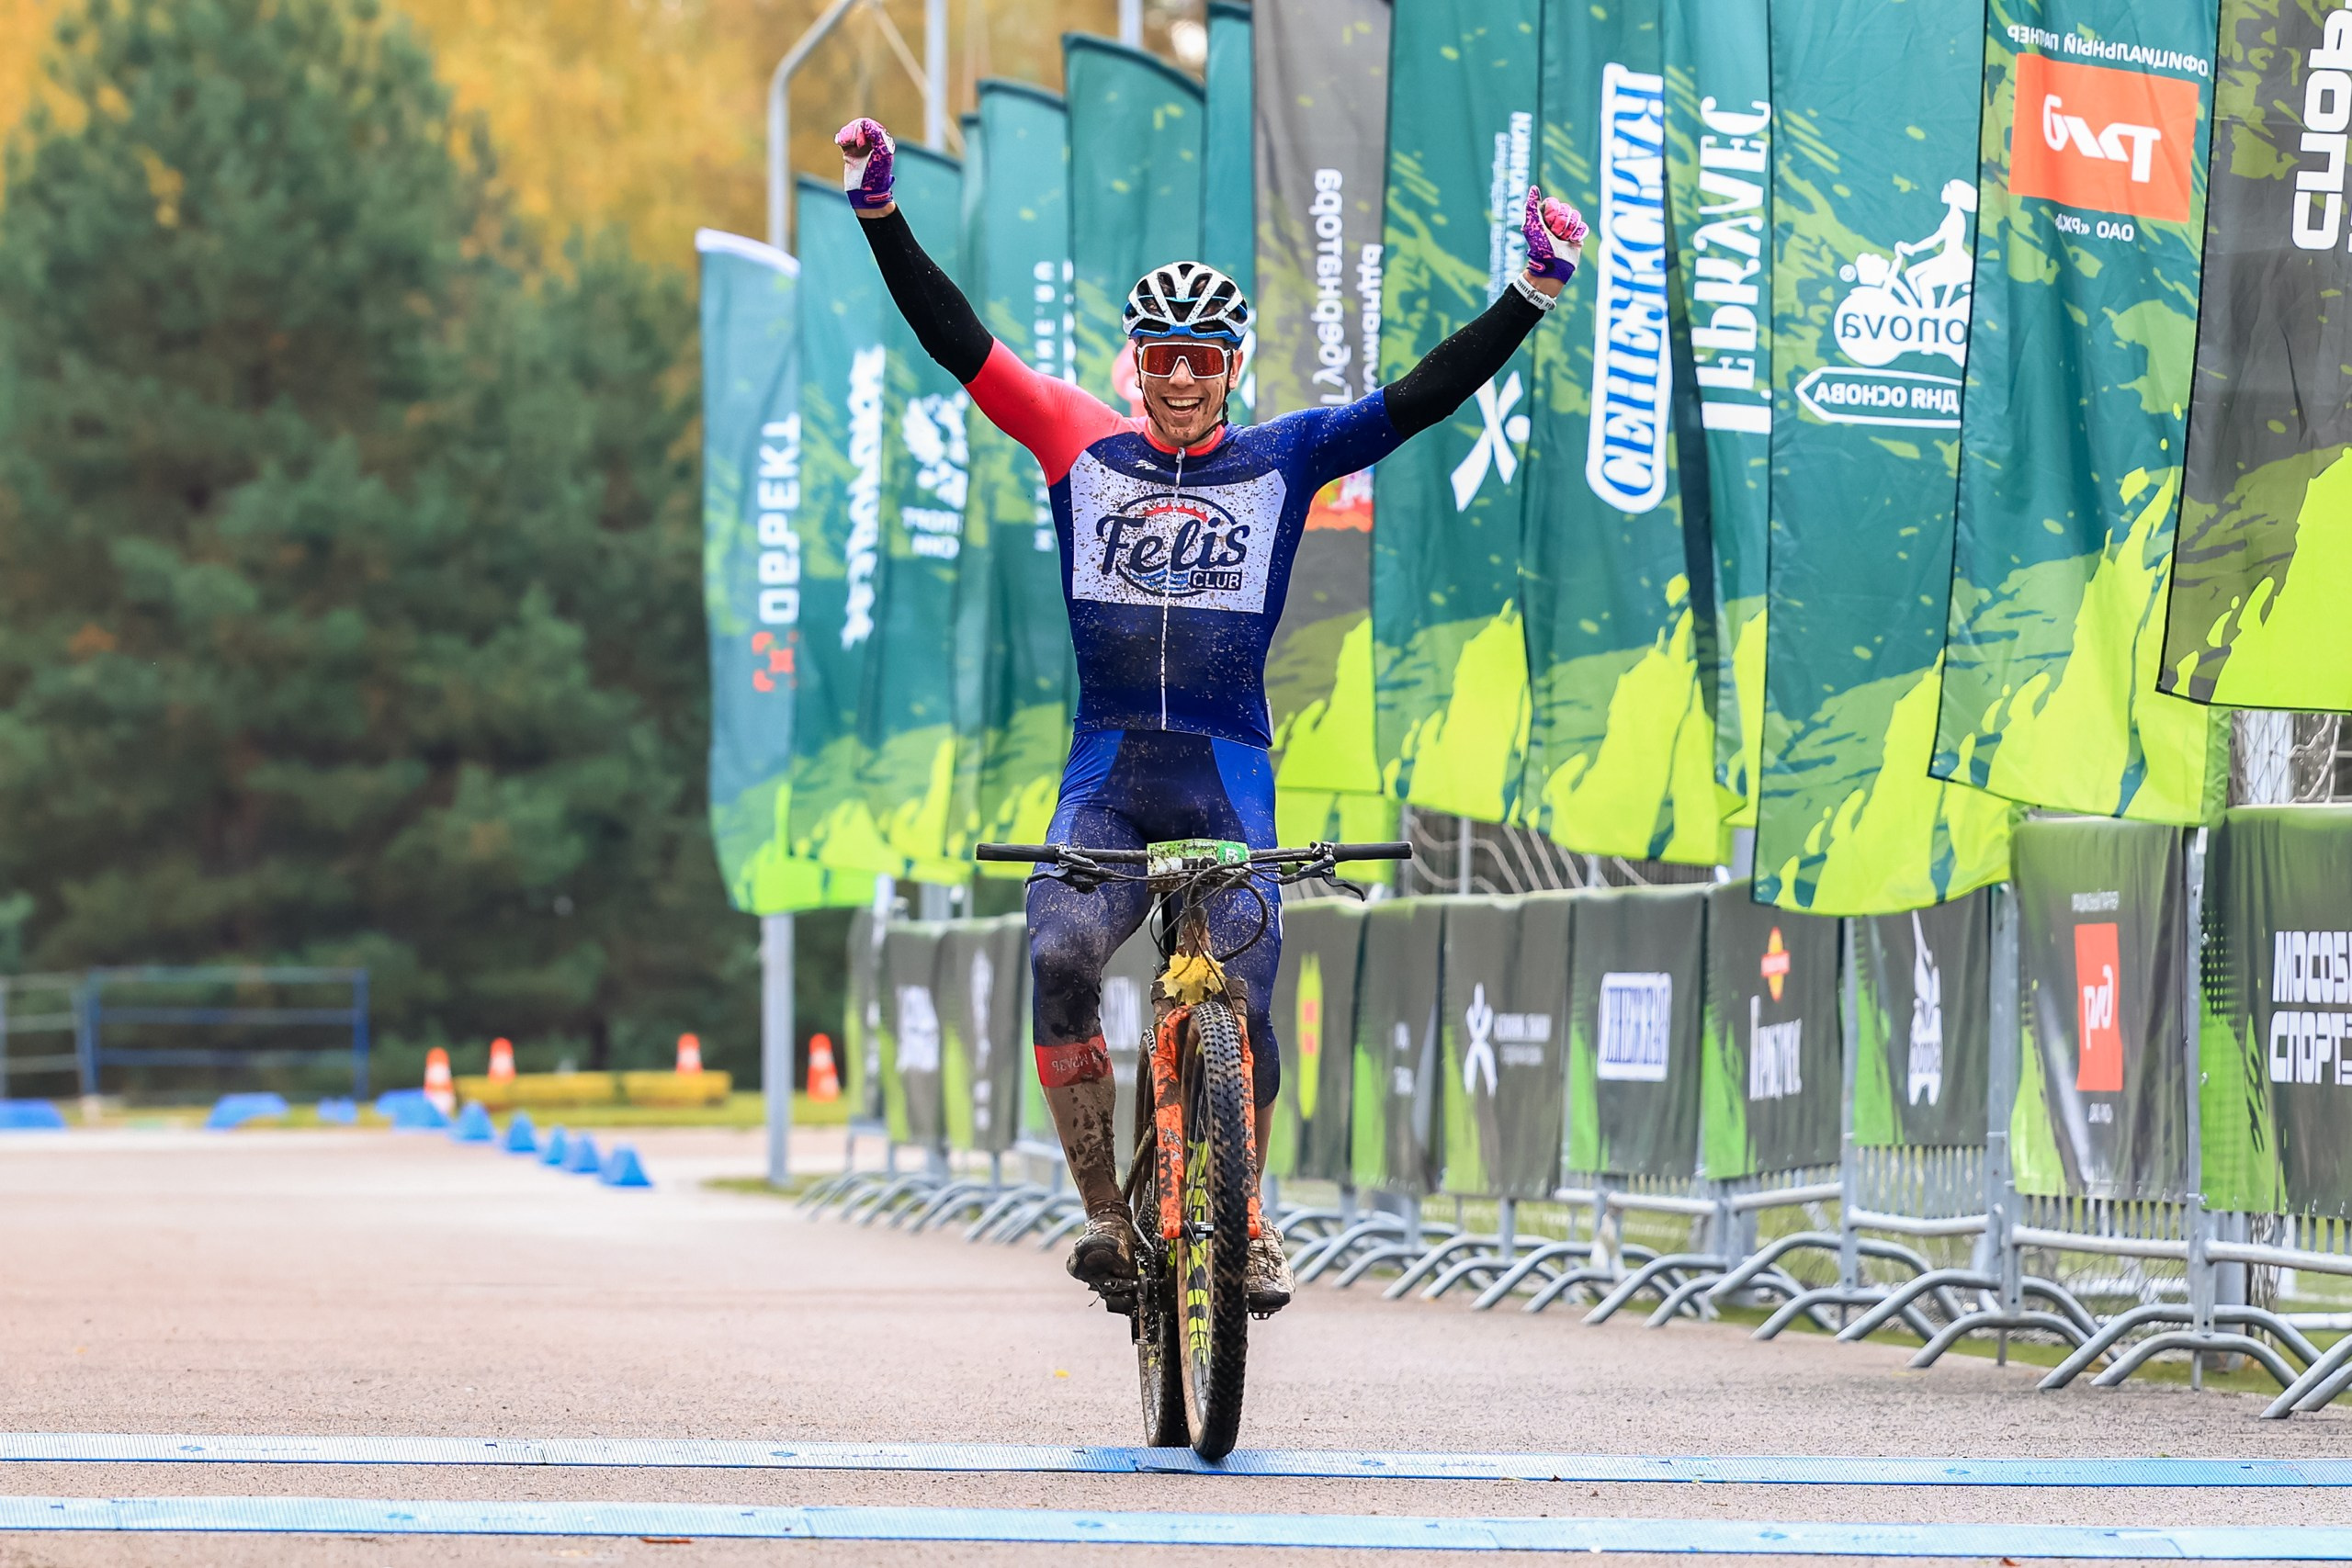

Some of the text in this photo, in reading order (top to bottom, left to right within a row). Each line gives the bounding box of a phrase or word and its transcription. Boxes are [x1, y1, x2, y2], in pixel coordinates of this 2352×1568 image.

[1095, 513, 1250, 576] Felis
[1193, 570, 1241, 590] CLUB
[2272, 931, 2352, 1004] МОСОБ
